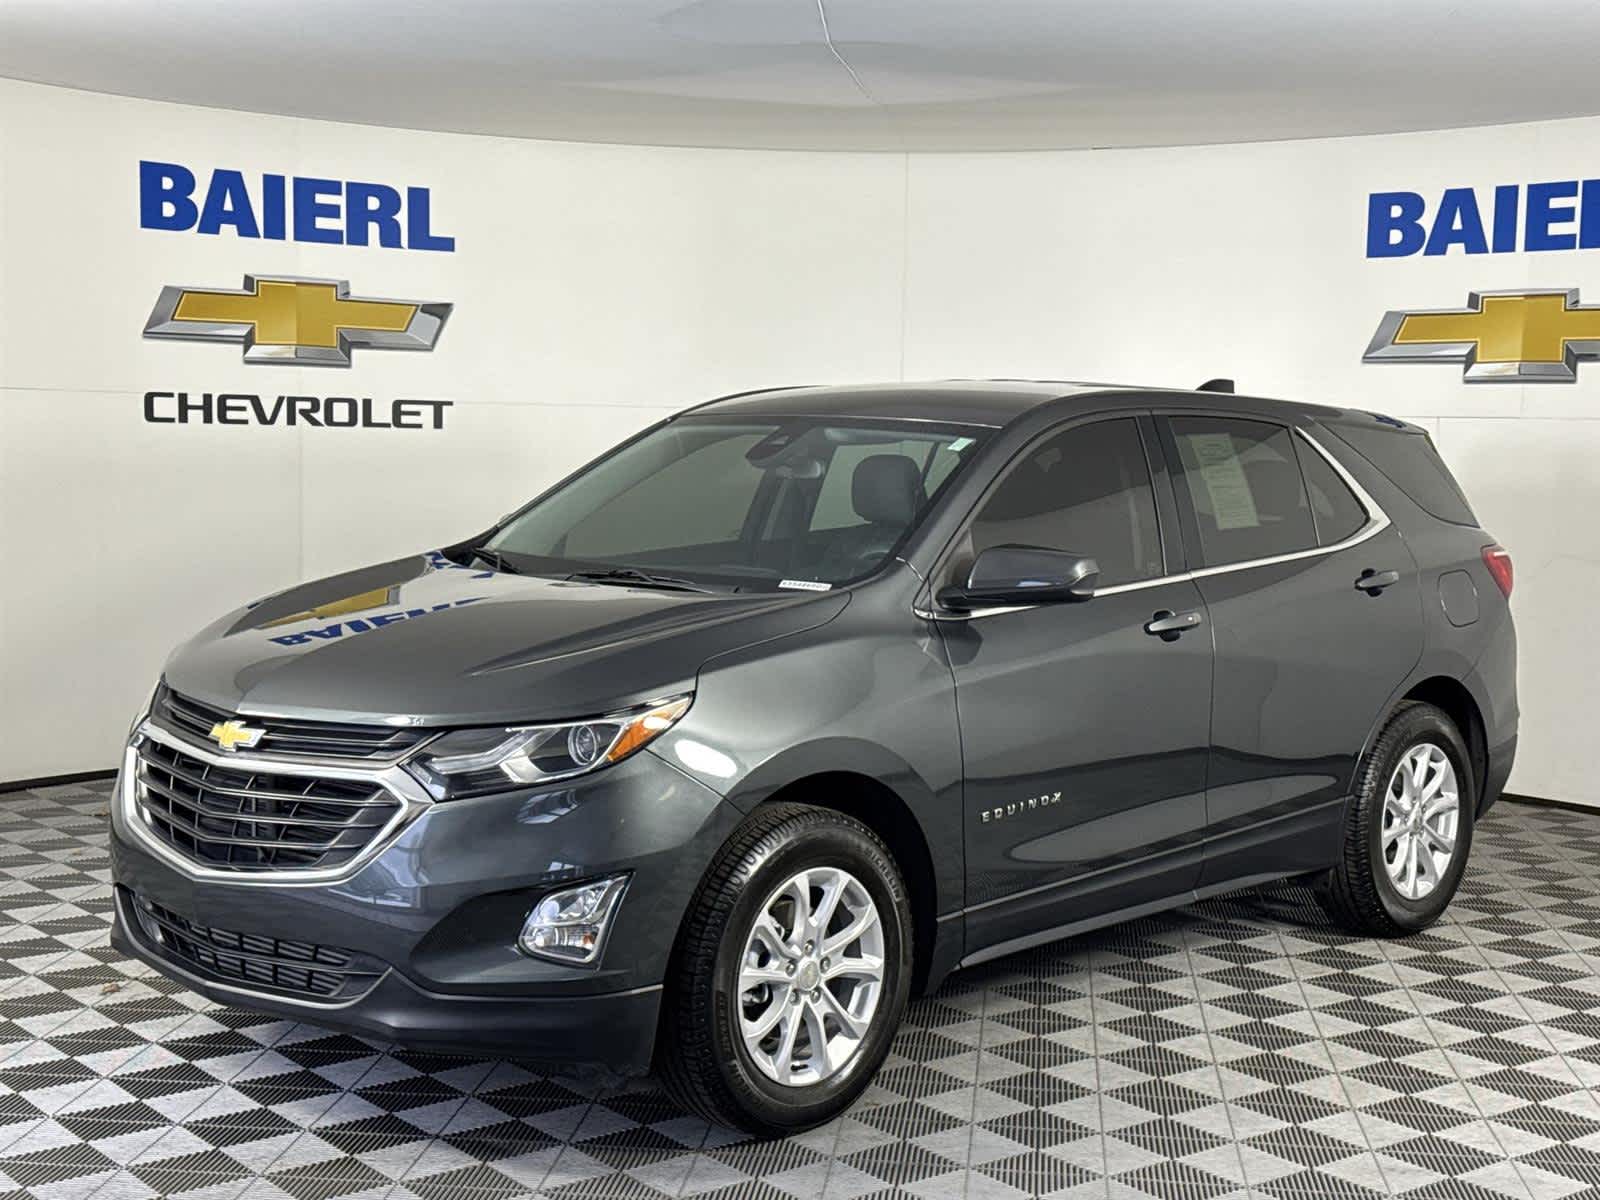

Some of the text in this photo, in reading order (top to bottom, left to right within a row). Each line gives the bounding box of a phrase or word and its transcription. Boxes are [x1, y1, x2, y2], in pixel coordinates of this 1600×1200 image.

[139, 160, 456, 252] BAIERL
[143, 391, 454, 429] CHEVROLET
[981, 791, 1062, 823] EQUINOX
